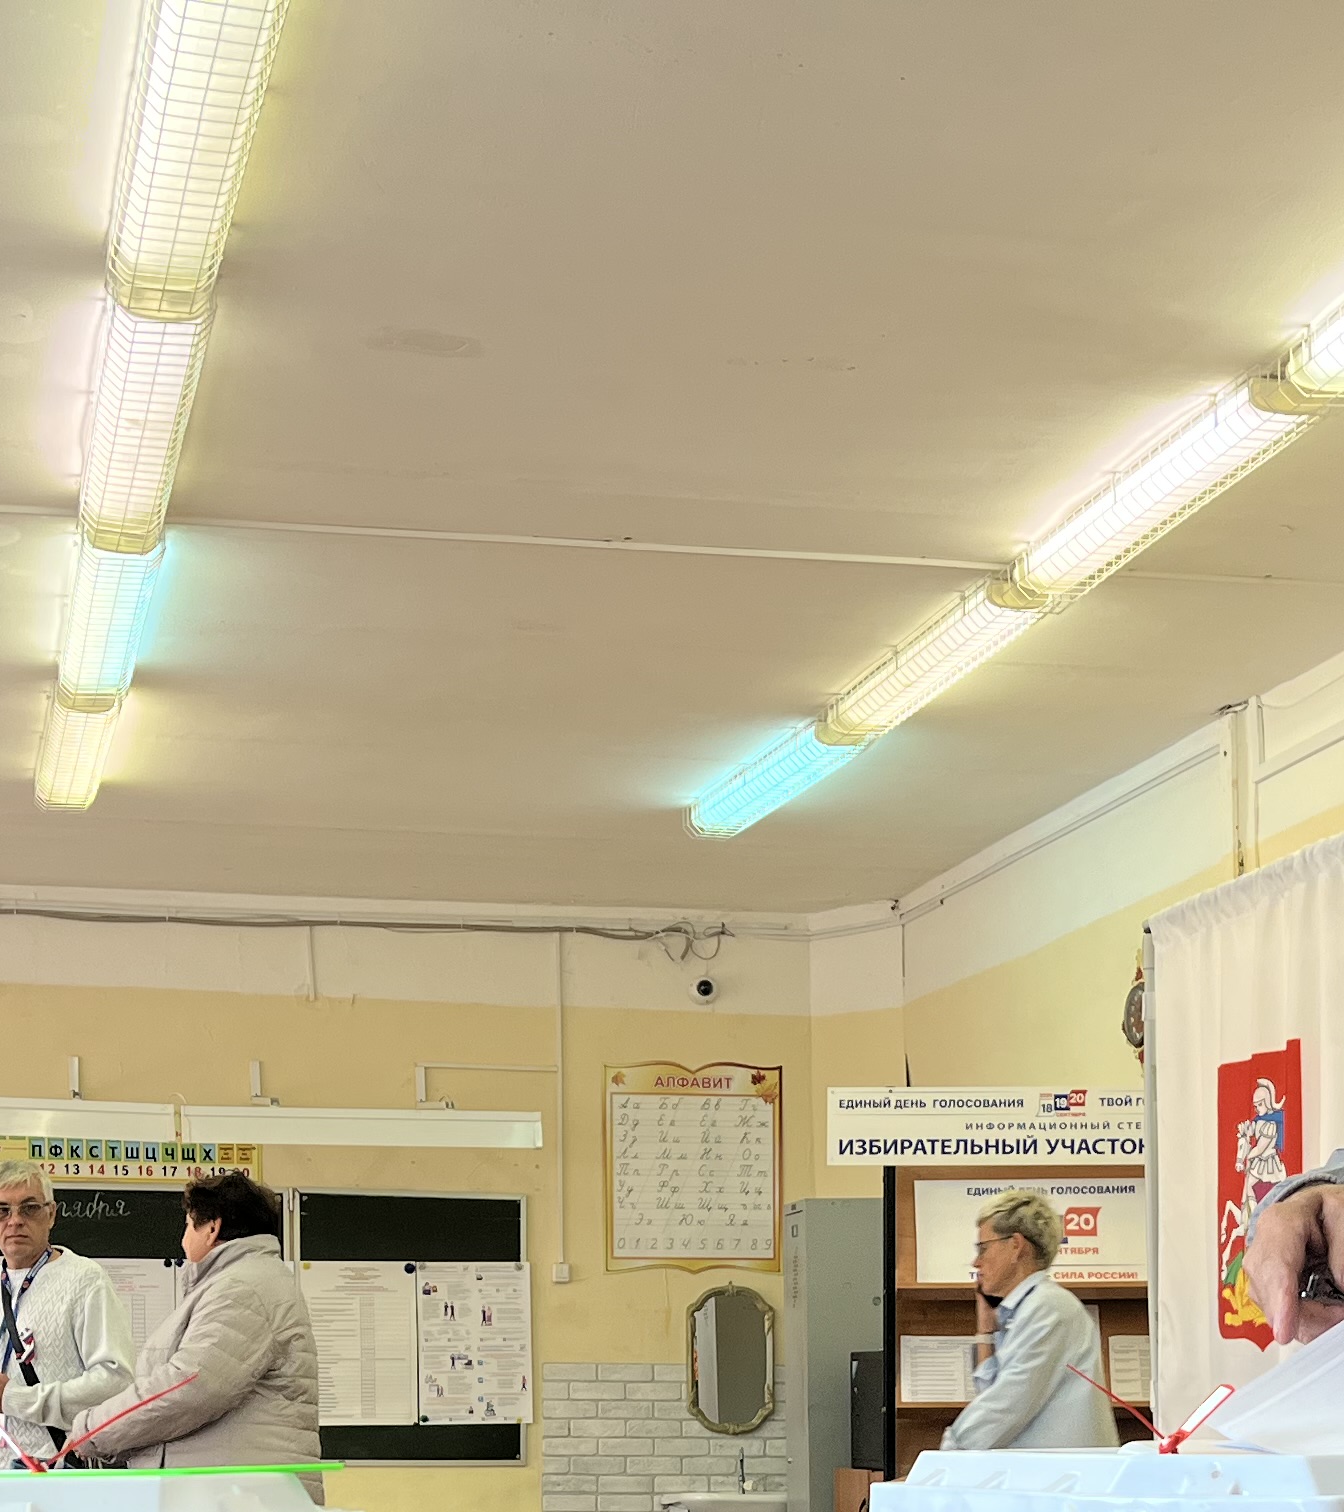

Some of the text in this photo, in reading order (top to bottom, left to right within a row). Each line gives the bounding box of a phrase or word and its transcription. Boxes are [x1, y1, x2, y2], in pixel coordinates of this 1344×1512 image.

[654, 1075, 733, 1089] АЛФАВИТ
[839, 1097, 1024, 1109] ЕДИНЫЙ ДЕНЬ ГОЛОСОВАНИЯ
[1069, 1092, 1085, 1104] 20
[1099, 1095, 1133, 1107] ТВОЙ
[965, 1121, 1142, 1131] ИНФОРМАЦИОННЫЙ СТЕ
[839, 1135, 1038, 1155] ИЗБИРАТЕЛЬНЫЙ
[31, 1144, 42, 1157] П
[49, 1144, 63, 1157] Ф
[70, 1145, 81, 1158] К
[89, 1145, 99, 1158] С
[109, 1146, 118, 1159] Т
[125, 1146, 139, 1159] Ш
[145, 1147, 157, 1162] Ц
[165, 1147, 175, 1160] Ч
[181, 1148, 196, 1163] Щ
[203, 1148, 213, 1161] Х
[64, 1164, 80, 1175] 13
[89, 1164, 105, 1175] 14
[114, 1164, 129, 1176] 15
[138, 1165, 153, 1176] 16
[162, 1166, 177, 1176] 17
[1051, 1185, 1136, 1195] ГОЛОСОВАНИЯ
[1065, 1213, 1095, 1230] 20
[1058, 1247, 1099, 1255] ТЯБРЯ
[1054, 1271, 1138, 1280] СИЛА РОССИИ!
